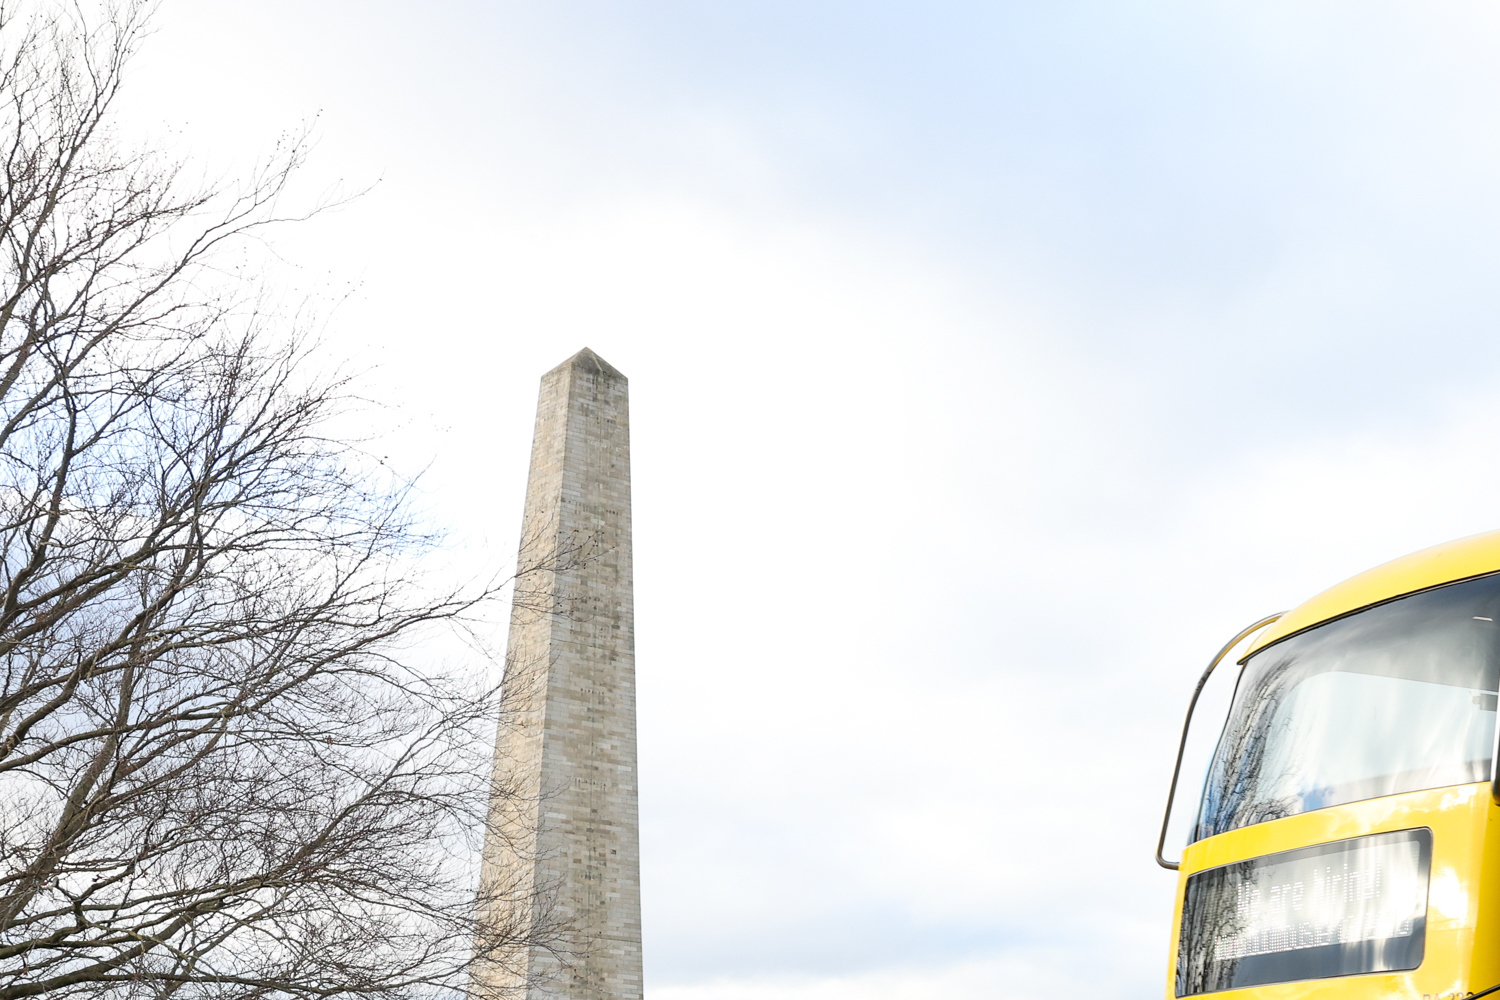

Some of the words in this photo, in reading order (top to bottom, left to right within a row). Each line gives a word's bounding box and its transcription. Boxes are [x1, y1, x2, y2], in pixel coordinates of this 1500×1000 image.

[1237, 881, 1261, 919] We
[1269, 881, 1305, 915] are
[1313, 857, 1381, 906] hiring!
